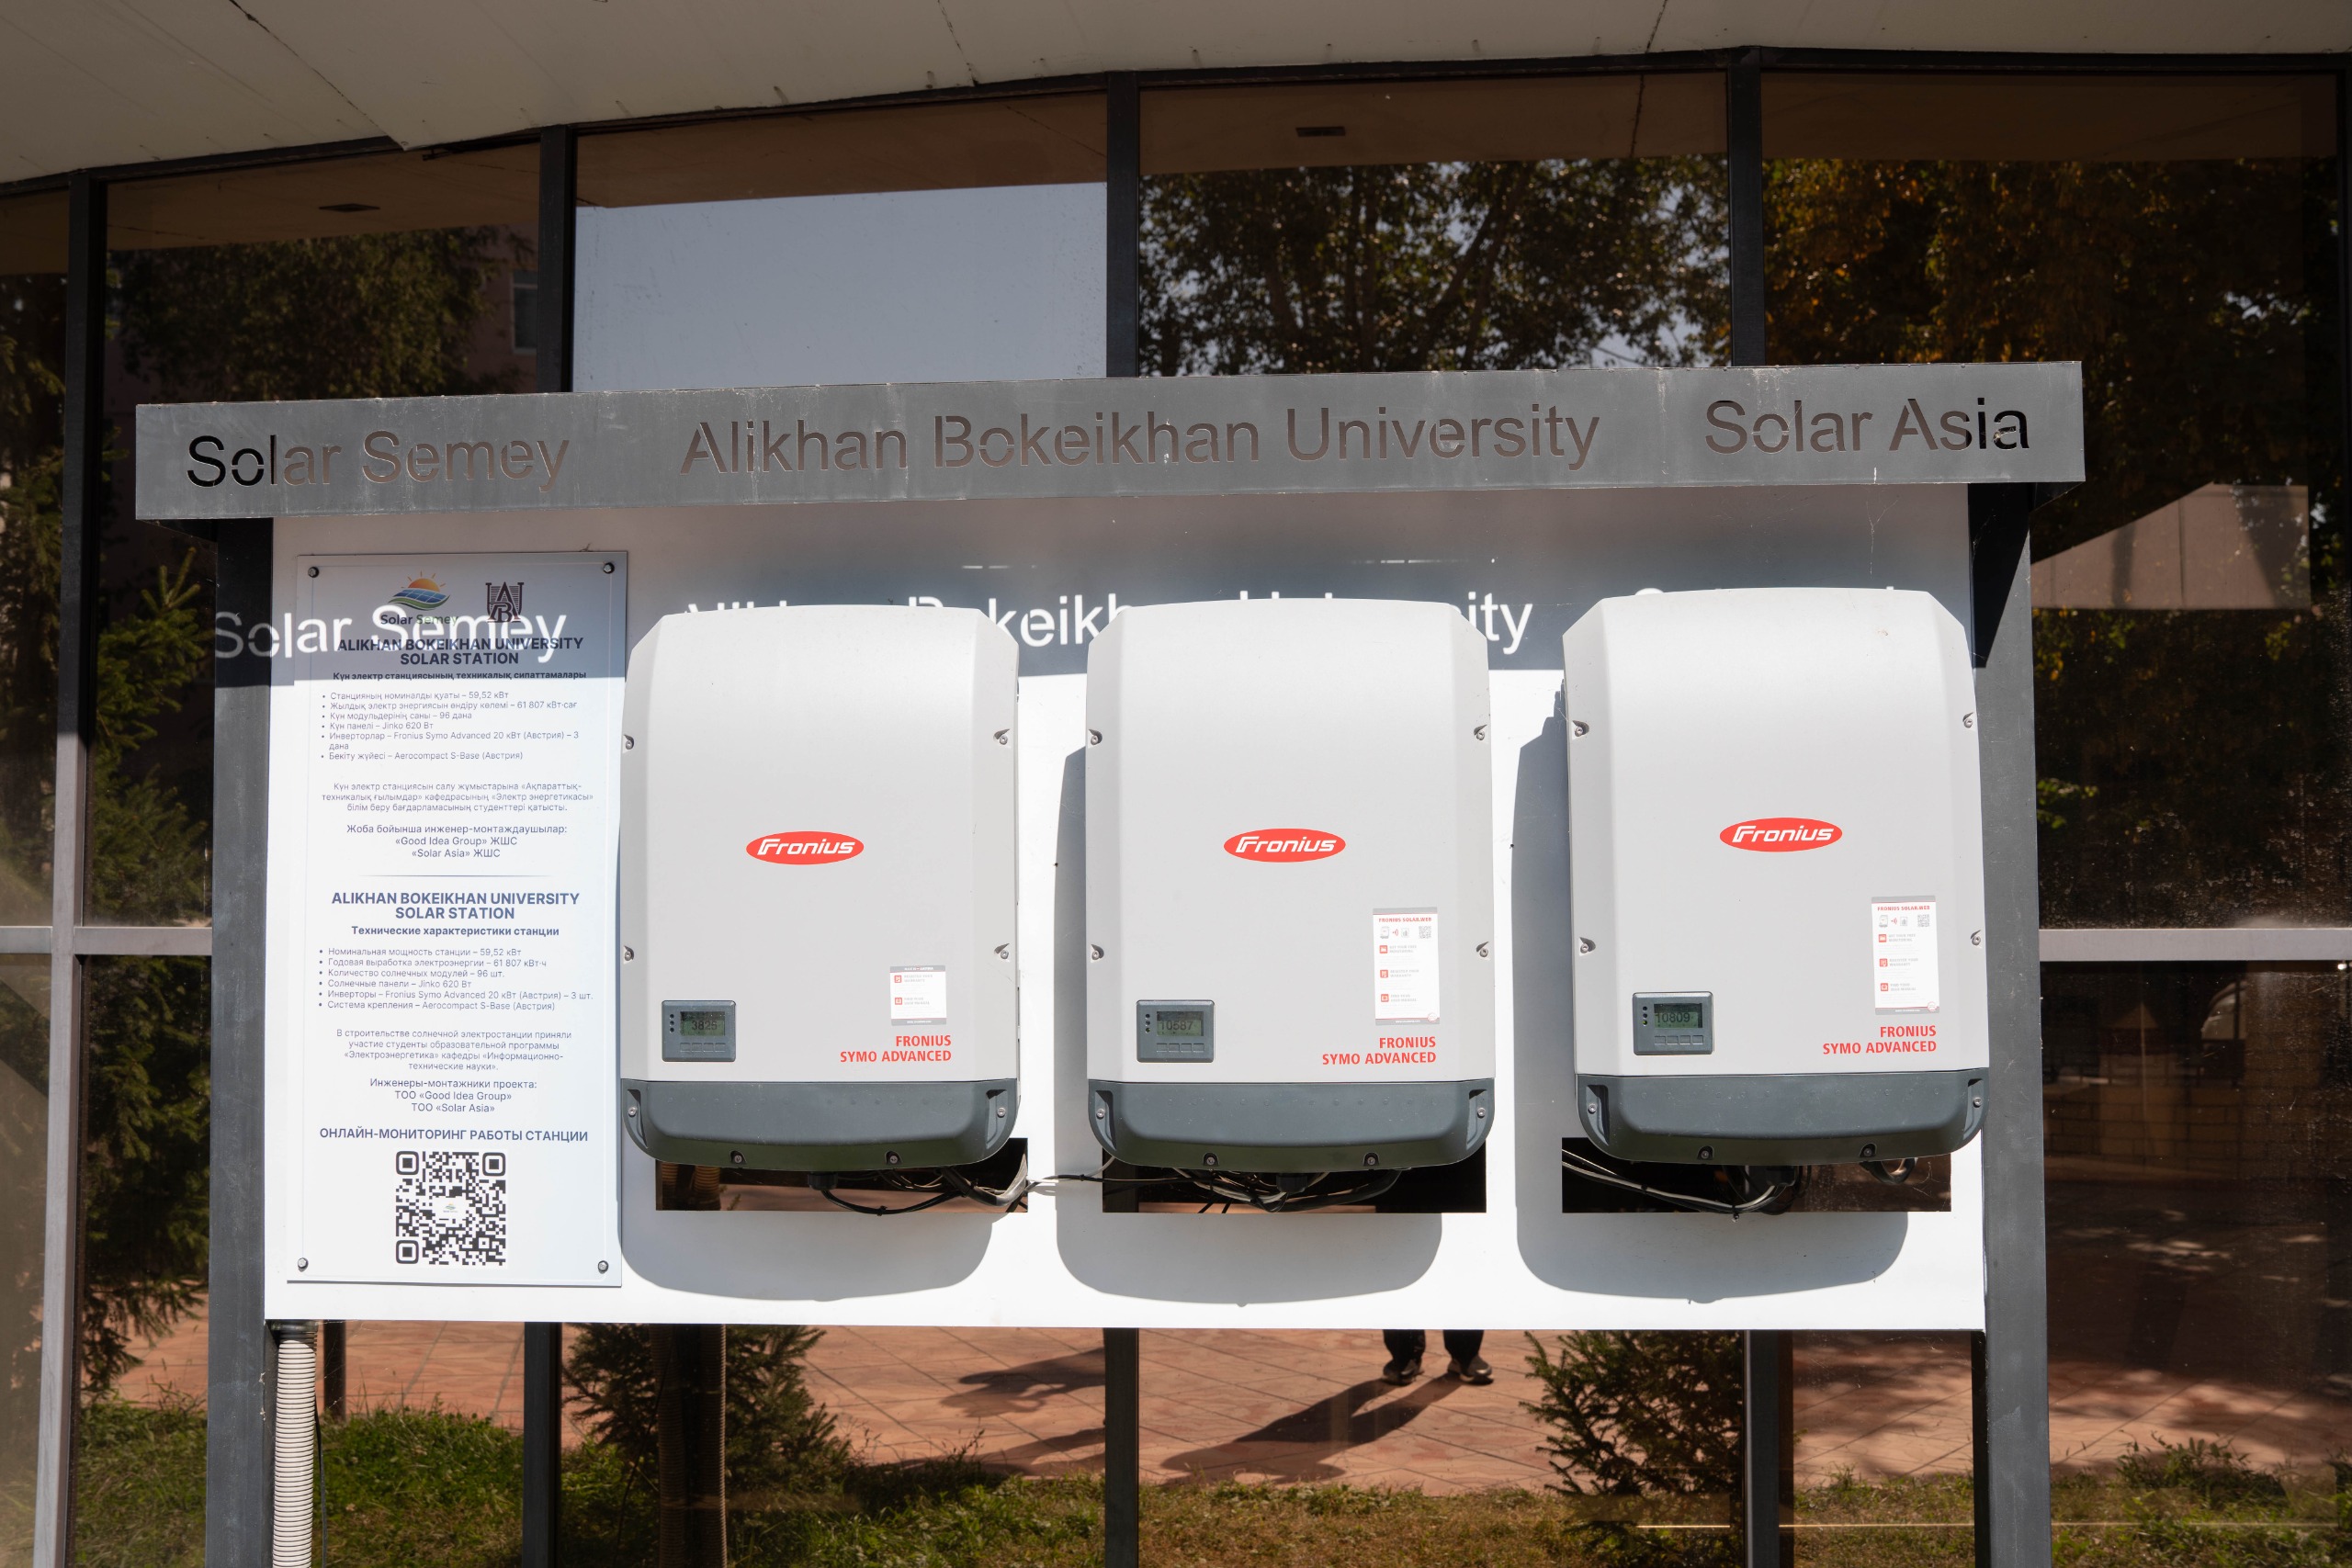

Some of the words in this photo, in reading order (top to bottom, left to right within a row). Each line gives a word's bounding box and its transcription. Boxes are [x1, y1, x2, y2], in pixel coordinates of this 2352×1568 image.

[1705, 399, 1873, 454] Solar
[1889, 397, 2030, 451] Asia
[681, 419, 908, 475] Alikhan
[934, 412, 1260, 468] Bokeikhan
[1286, 403, 1600, 470] University
[187, 434, 342, 487] Solar
[362, 430, 570, 492] Semey
[380, 614, 413, 625] Solar
[215, 611, 352, 660] Solar
[371, 604, 567, 663] Semey
[337, 639, 401, 651] ALIKHAN
[406, 637, 492, 650] BOKEIKHAN
[495, 637, 584, 650] UNIVERSITY
[401, 652, 449, 665] SOLAR
[453, 652, 519, 664] STATION
[333, 672, 350, 682] Күн
[351, 673, 384, 682] электр
[469, 691, 492, 700] 59,52
[493, 691, 509, 699] кВт
[330, 702, 367, 711] Жылдық
[368, 703, 397, 711] электр
[399, 703, 448, 711] энергиясын
[450, 702, 478, 711] өндіру
[480, 701, 509, 709] көлемі
[330, 712, 345, 721] Күн
[439, 711, 450, 719] 96
[330, 722, 345, 731] Күн
[346, 720, 374, 729] панелі
[329, 732, 386, 741] Инверторлар
[393, 731, 424, 739] Fronius
[425, 731, 448, 741] Symo
[450, 731, 492, 739] Advanced
[493, 731, 504, 739] 20
[506, 731, 521, 739] кВт
[523, 731, 565, 740] (Австрия)
[329, 751, 356, 761] Бекіту
[357, 751, 386, 761] жүйесі
[394, 751, 448, 761] Aerocompact
[450, 751, 480, 760] S-Base
[481, 751, 523, 761] (Австрия)
[346, 803, 368, 811] білім
[369, 803, 390, 813] беру
[346, 824, 374, 833] Жоба
[376, 825, 422, 833] бойынша
[424, 826, 567, 835] инженер-монтаждаушылар:
[1732, 825, 1834, 842] Fronius
[395, 836, 426, 845] «Good
[429, 837, 450, 845] Idea
[452, 836, 487, 847] Group»
[490, 837, 517, 845] ЖШС
[757, 838, 855, 855] Fronius
[1235, 836, 1337, 852] Fronius
[412, 849, 442, 858] «Solar
[444, 849, 470, 858] Asia»
[473, 849, 501, 857] ЖШС
[332, 892, 397, 904] ALIKHAN
[401, 893, 487, 904] BOKEIKHAN
[491, 893, 580, 905] UNIVERSITY
[395, 907, 445, 919] SOLAR
[448, 907, 514, 919] STATION
[351, 926, 421, 935] Технические
[423, 928, 512, 938] характеристики
[514, 928, 560, 937] станции
[435, 949, 471, 957] станции
[480, 948, 504, 957] 59,52
[506, 948, 522, 956] кВт
[328, 958, 364, 967] Годовая
[366, 958, 413, 968] выработка
[414, 960, 484, 968] электроэнергии
[328, 968, 379, 977] Количество
[430, 969, 469, 979] модулей
[477, 969, 489, 977] 96
[327, 979, 377, 987] Солнечные
[418, 979, 441, 987] Jinko
[442, 979, 459, 988] 620
[461, 980, 472, 988] Вт
[327, 990, 377, 999] Инверторы
[385, 990, 416, 998] Fronius
[418, 991, 442, 1000] Symo
[443, 990, 486, 999] Advanced
[488, 990, 500, 999] 20
[501, 990, 516, 999] кВт
[519, 991, 561, 1000] (Австрия)
[327, 1000, 366, 1009] Система
[368, 1002, 413, 1010] крепления
[422, 1001, 478, 1010] Aerocompact
[480, 1001, 511, 1010] S-Base
[513, 1001, 555, 1011] (Австрия)
[1656, 1012, 1690, 1022] 10809
[691, 1021, 718, 1031] 3825
[1880, 1025, 1937, 1037] FRONIUS
[895, 1035, 952, 1046] FRONIUS
[1379, 1036, 1436, 1049] FRONIUS
[1823, 1043, 1861, 1055] SYMO
[1866, 1041, 1937, 1054] ADVANCED
[441, 1050, 481, 1061] кафедры
[840, 1051, 877, 1062] SYMO
[882, 1050, 952, 1062] ADVANCED
[1322, 1053, 1361, 1065] SYMO
[1364, 1052, 1436, 1064] ADVANCED
[466, 1064, 499, 1072] науки».
[369, 1078, 491, 1089] Инженеры-монтажники
[493, 1081, 537, 1090] проекта:
[394, 1090, 417, 1100] ТОО
[419, 1090, 451, 1100] «Good
[453, 1091, 474, 1100] Idea
[476, 1091, 512, 1102] Group»
[411, 1102, 434, 1111] ТОО
[435, 1103, 467, 1111] «Solar
[469, 1103, 495, 1112] Asia»
[320, 1125, 467, 1140] ОНЛАЙН-МОНИТОРИНГ
[469, 1130, 523, 1141] РАБОТЫ
[525, 1130, 588, 1144] СТАНЦИИ
